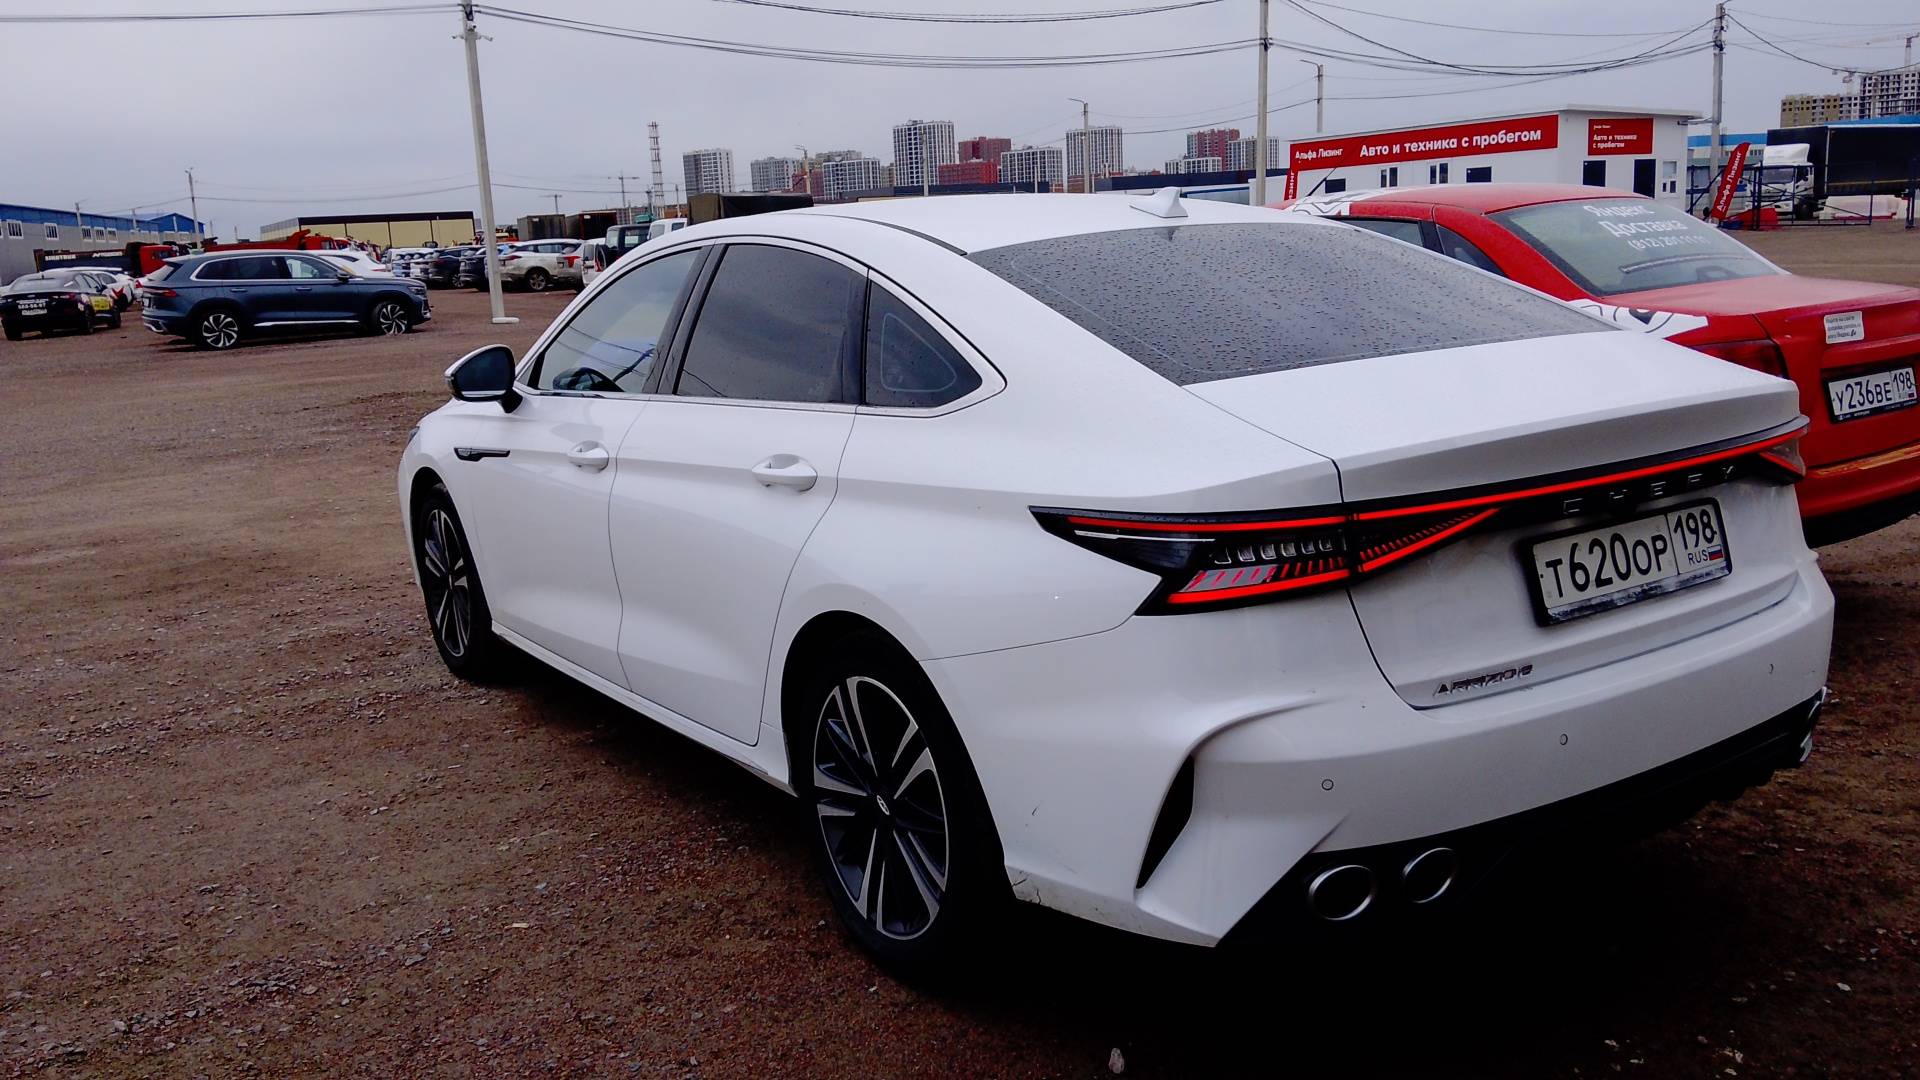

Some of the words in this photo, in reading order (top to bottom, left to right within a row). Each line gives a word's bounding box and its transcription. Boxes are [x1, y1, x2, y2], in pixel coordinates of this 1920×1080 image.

[1360, 144, 1389, 158] Авто
[1392, 143, 1400, 154] и
[1404, 137, 1458, 153] техника
[1461, 137, 1469, 148] с
[1472, 129, 1542, 149] пробегом
[1892, 371, 1913, 393] 198
[1545, 532, 1668, 598] Т620ОР
[1673, 508, 1718, 550] 198
[1687, 549, 1708, 567] RUS
